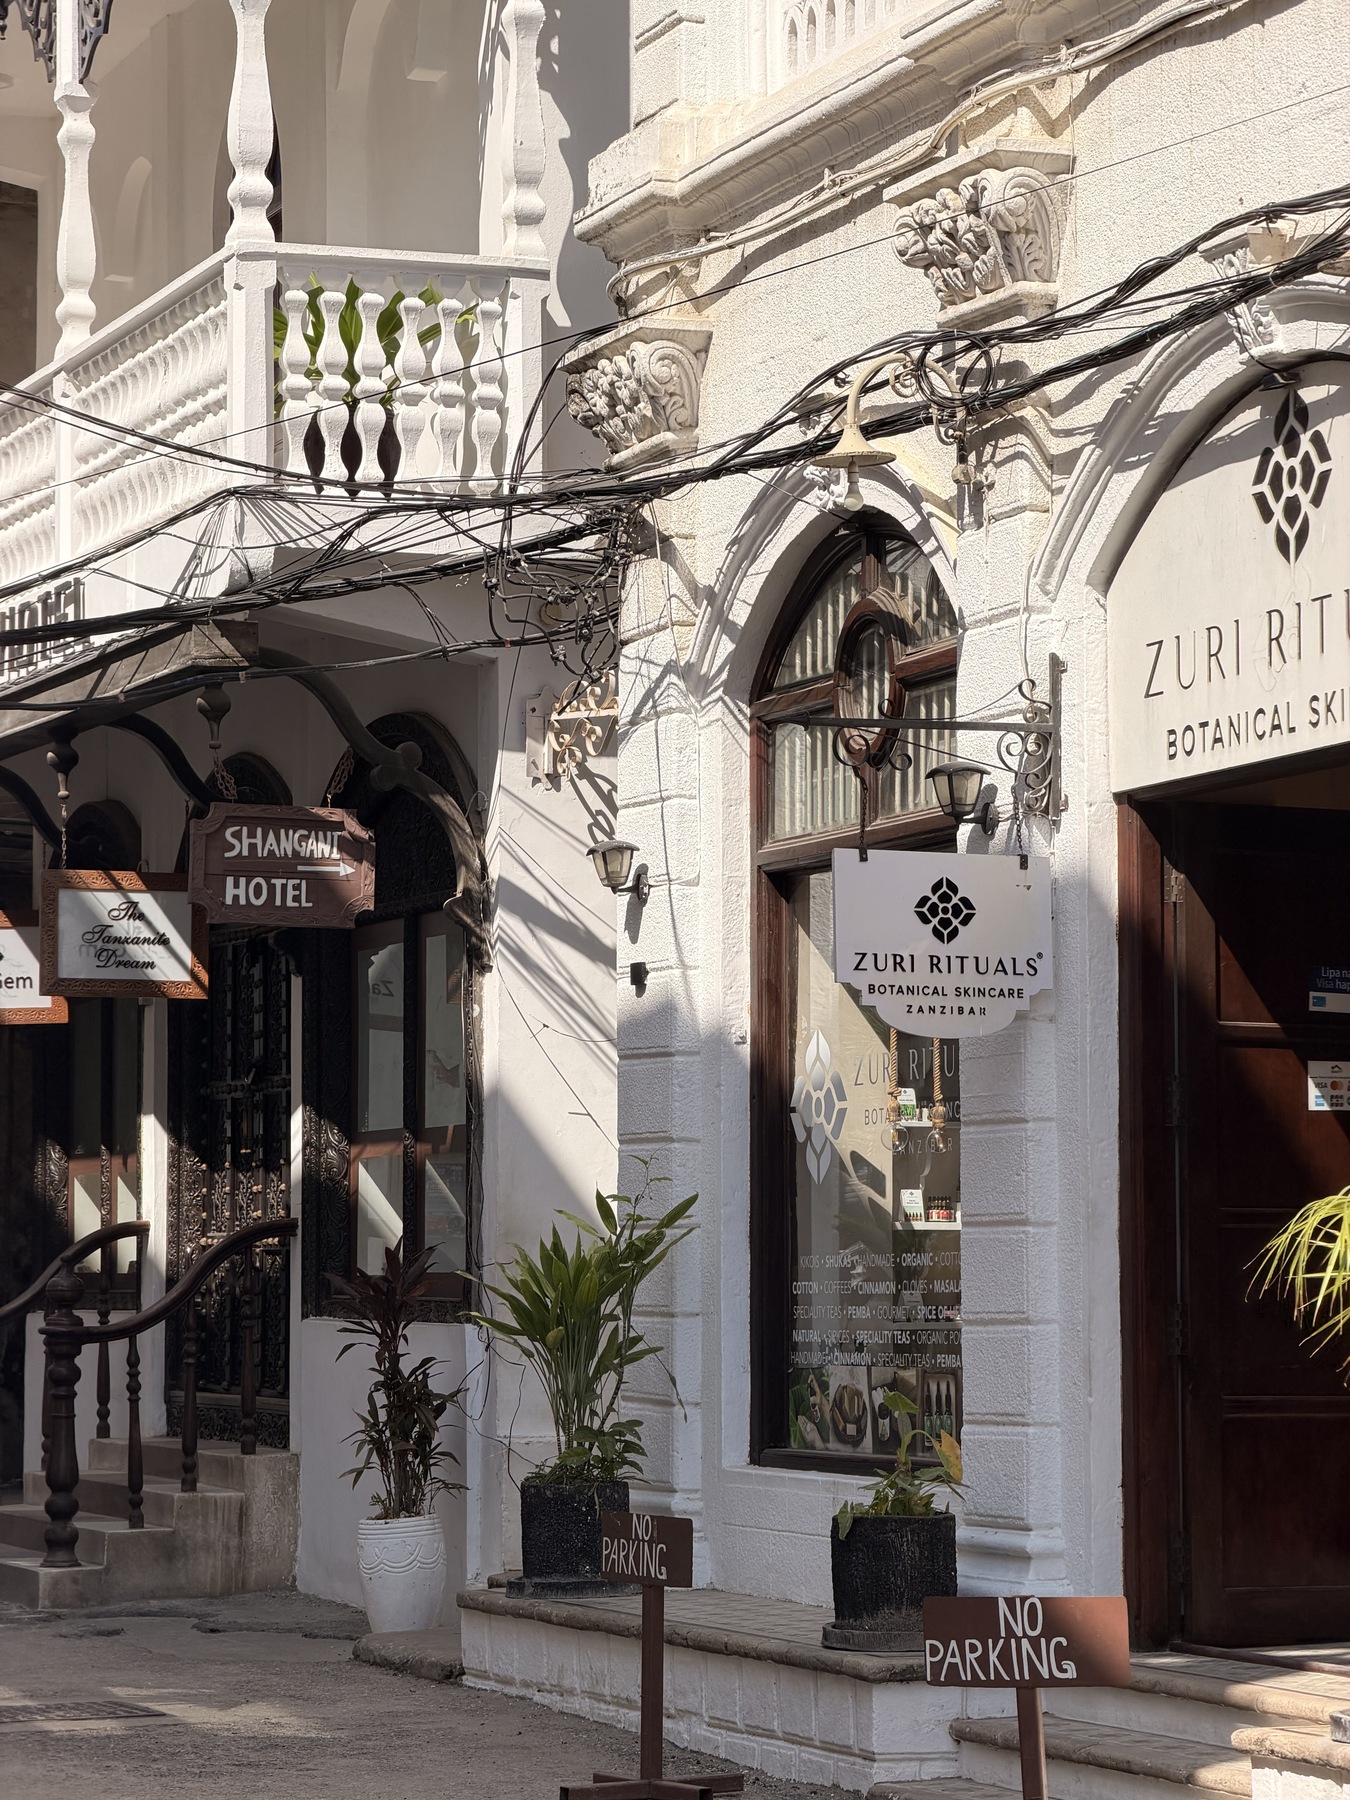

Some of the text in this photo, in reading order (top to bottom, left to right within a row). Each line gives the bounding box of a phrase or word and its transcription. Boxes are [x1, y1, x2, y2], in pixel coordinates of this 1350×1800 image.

[1144, 588, 1350, 698] ZURI RIT
[1166, 687, 1350, 760] BOTANICAL SKI
[224, 826, 341, 859] SHANGANI
[225, 876, 313, 907] HOTEL
[108, 901, 145, 921] The
[82, 925, 171, 946] Tanzanite
[95, 948, 156, 970] Dream
[853, 952, 915, 973] ZURI
[0, 972, 33, 990] em
[1321, 966, 1340, 979] Lipa
[868, 984, 1024, 999] BOTANICAL SKINCARE
[1316, 979, 1333, 988] Visa
[906, 1005, 987, 1016] ZANZIBAR
[901, 1252, 933, 1266] ORGANIC
[792, 1281, 819, 1294] COTTON
[823, 1281, 852, 1294] COFFEES
[858, 1281, 896, 1295] CINNAMON
[902, 1280, 928, 1294] CLOVES
[793, 1305, 826, 1318] SPECIALITY
[827, 1305, 842, 1318] TEAS
[847, 1305, 871, 1318] PEMBA
[877, 1305, 910, 1319] GOURMET
[917, 1305, 937, 1319] SPICE
[792, 1329, 821, 1343] NATURAL
[856, 1330, 893, 1344] SPECIALITY
[893, 1330, 911, 1344] TEAS
[916, 1330, 949, 1344] ORGANIC
[949, 1331, 961, 1344] PO
[914, 1353, 930, 1367] TEAS
[936, 1354, 961, 1367] PEMBA
[632, 1513, 652, 1540] NO
[603, 1537, 667, 1580] PARKING
[998, 1597, 1043, 1638] NO
[925, 1637, 1078, 1682] PARKING
